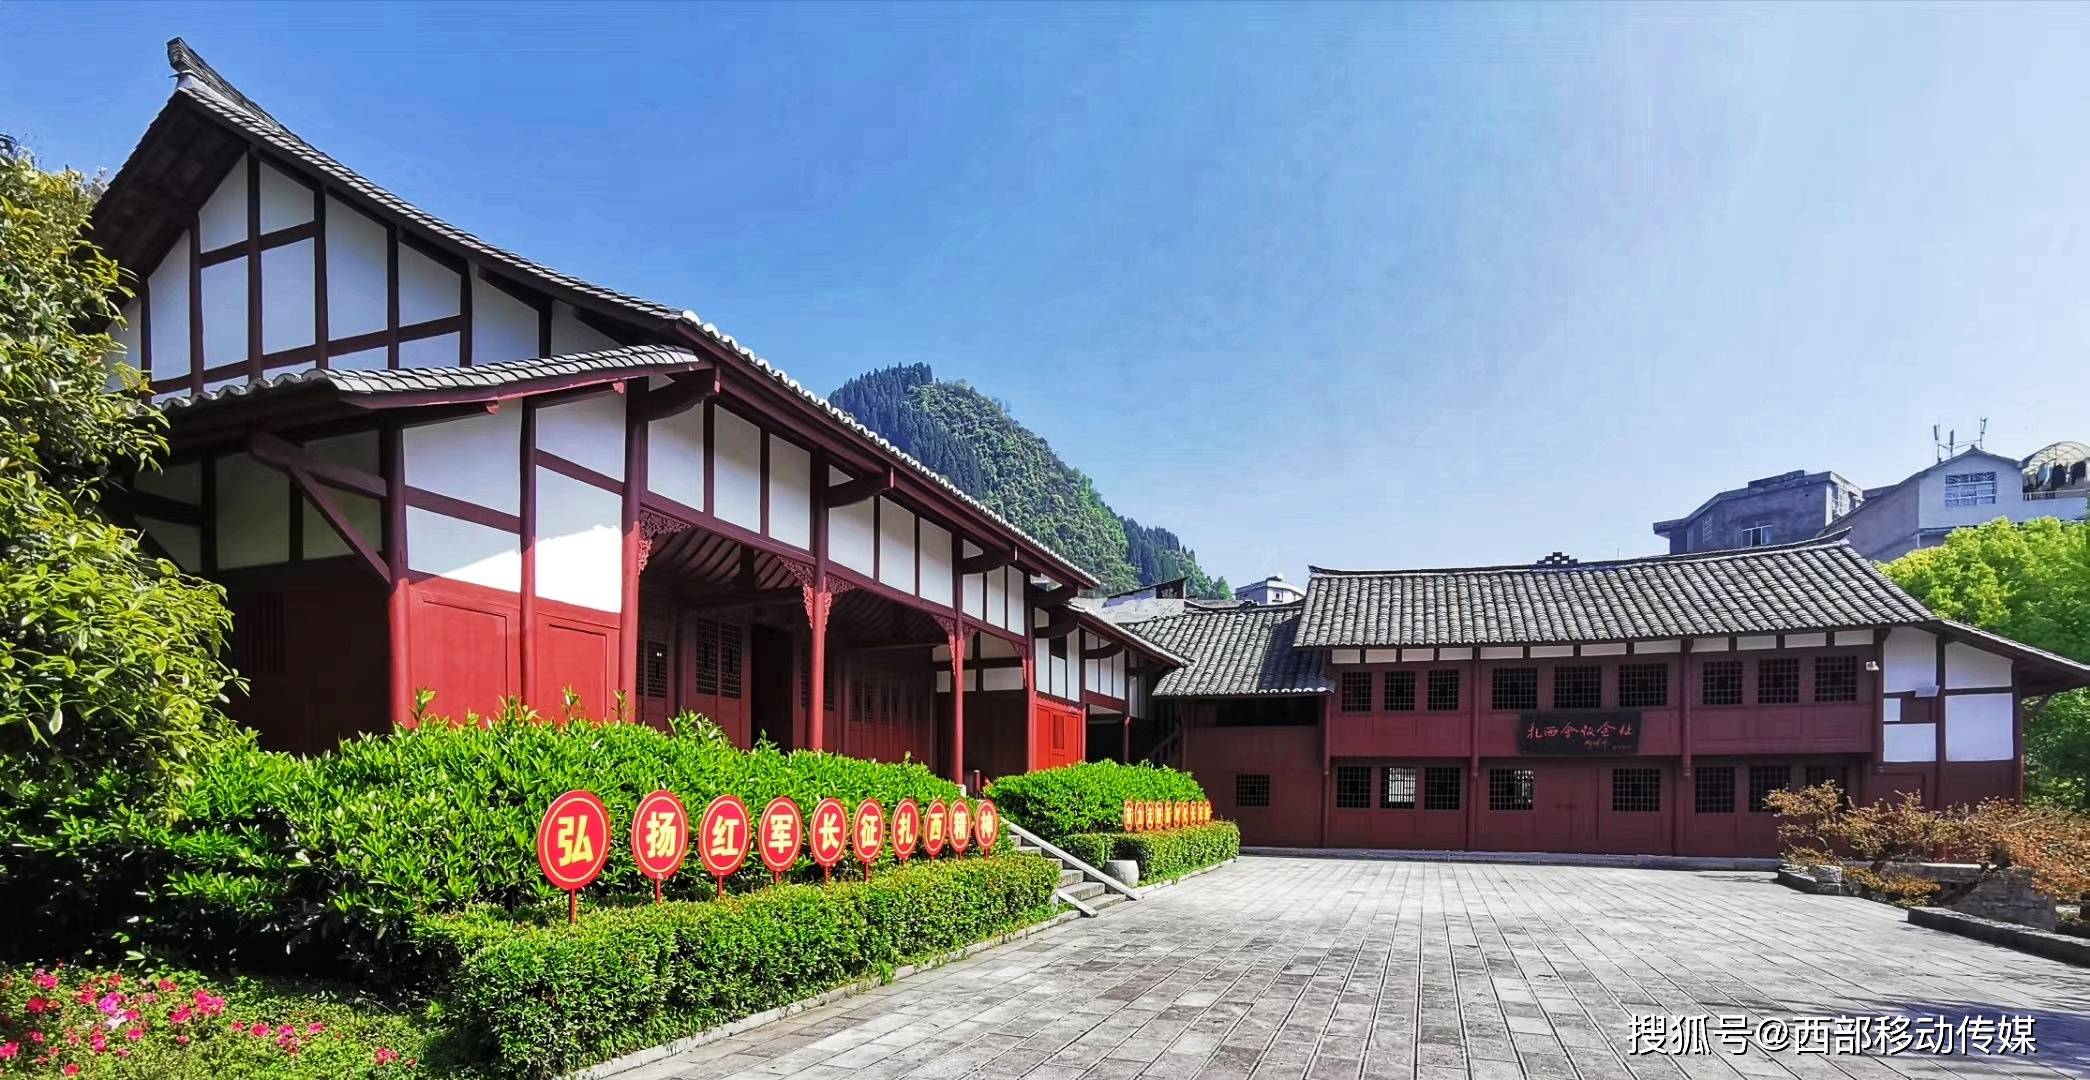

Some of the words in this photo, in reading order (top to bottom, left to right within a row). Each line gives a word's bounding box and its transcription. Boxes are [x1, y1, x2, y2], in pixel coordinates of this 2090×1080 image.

[556, 811, 994, 867] 弘扬红军长征扎西精神
